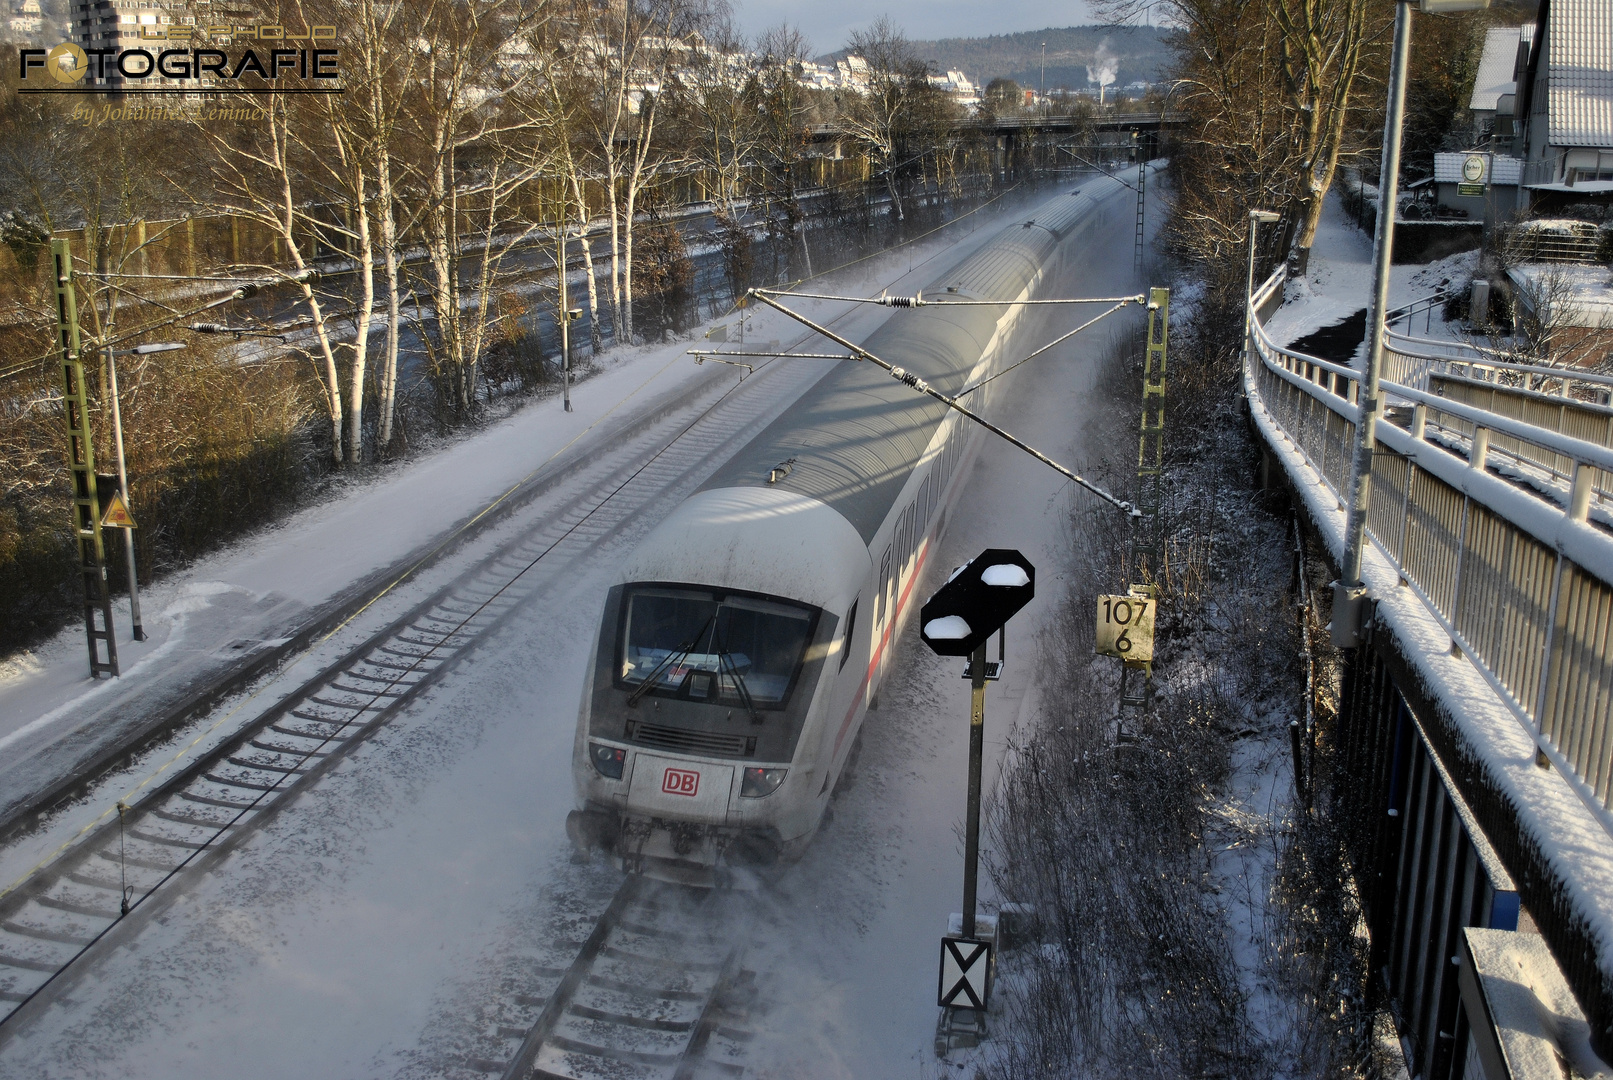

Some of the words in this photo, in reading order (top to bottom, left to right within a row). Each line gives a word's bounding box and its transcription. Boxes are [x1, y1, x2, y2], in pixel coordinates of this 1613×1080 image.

[1103, 599, 1149, 626] 107
[1115, 628, 1132, 652] 6
[665, 772, 696, 793] DB
